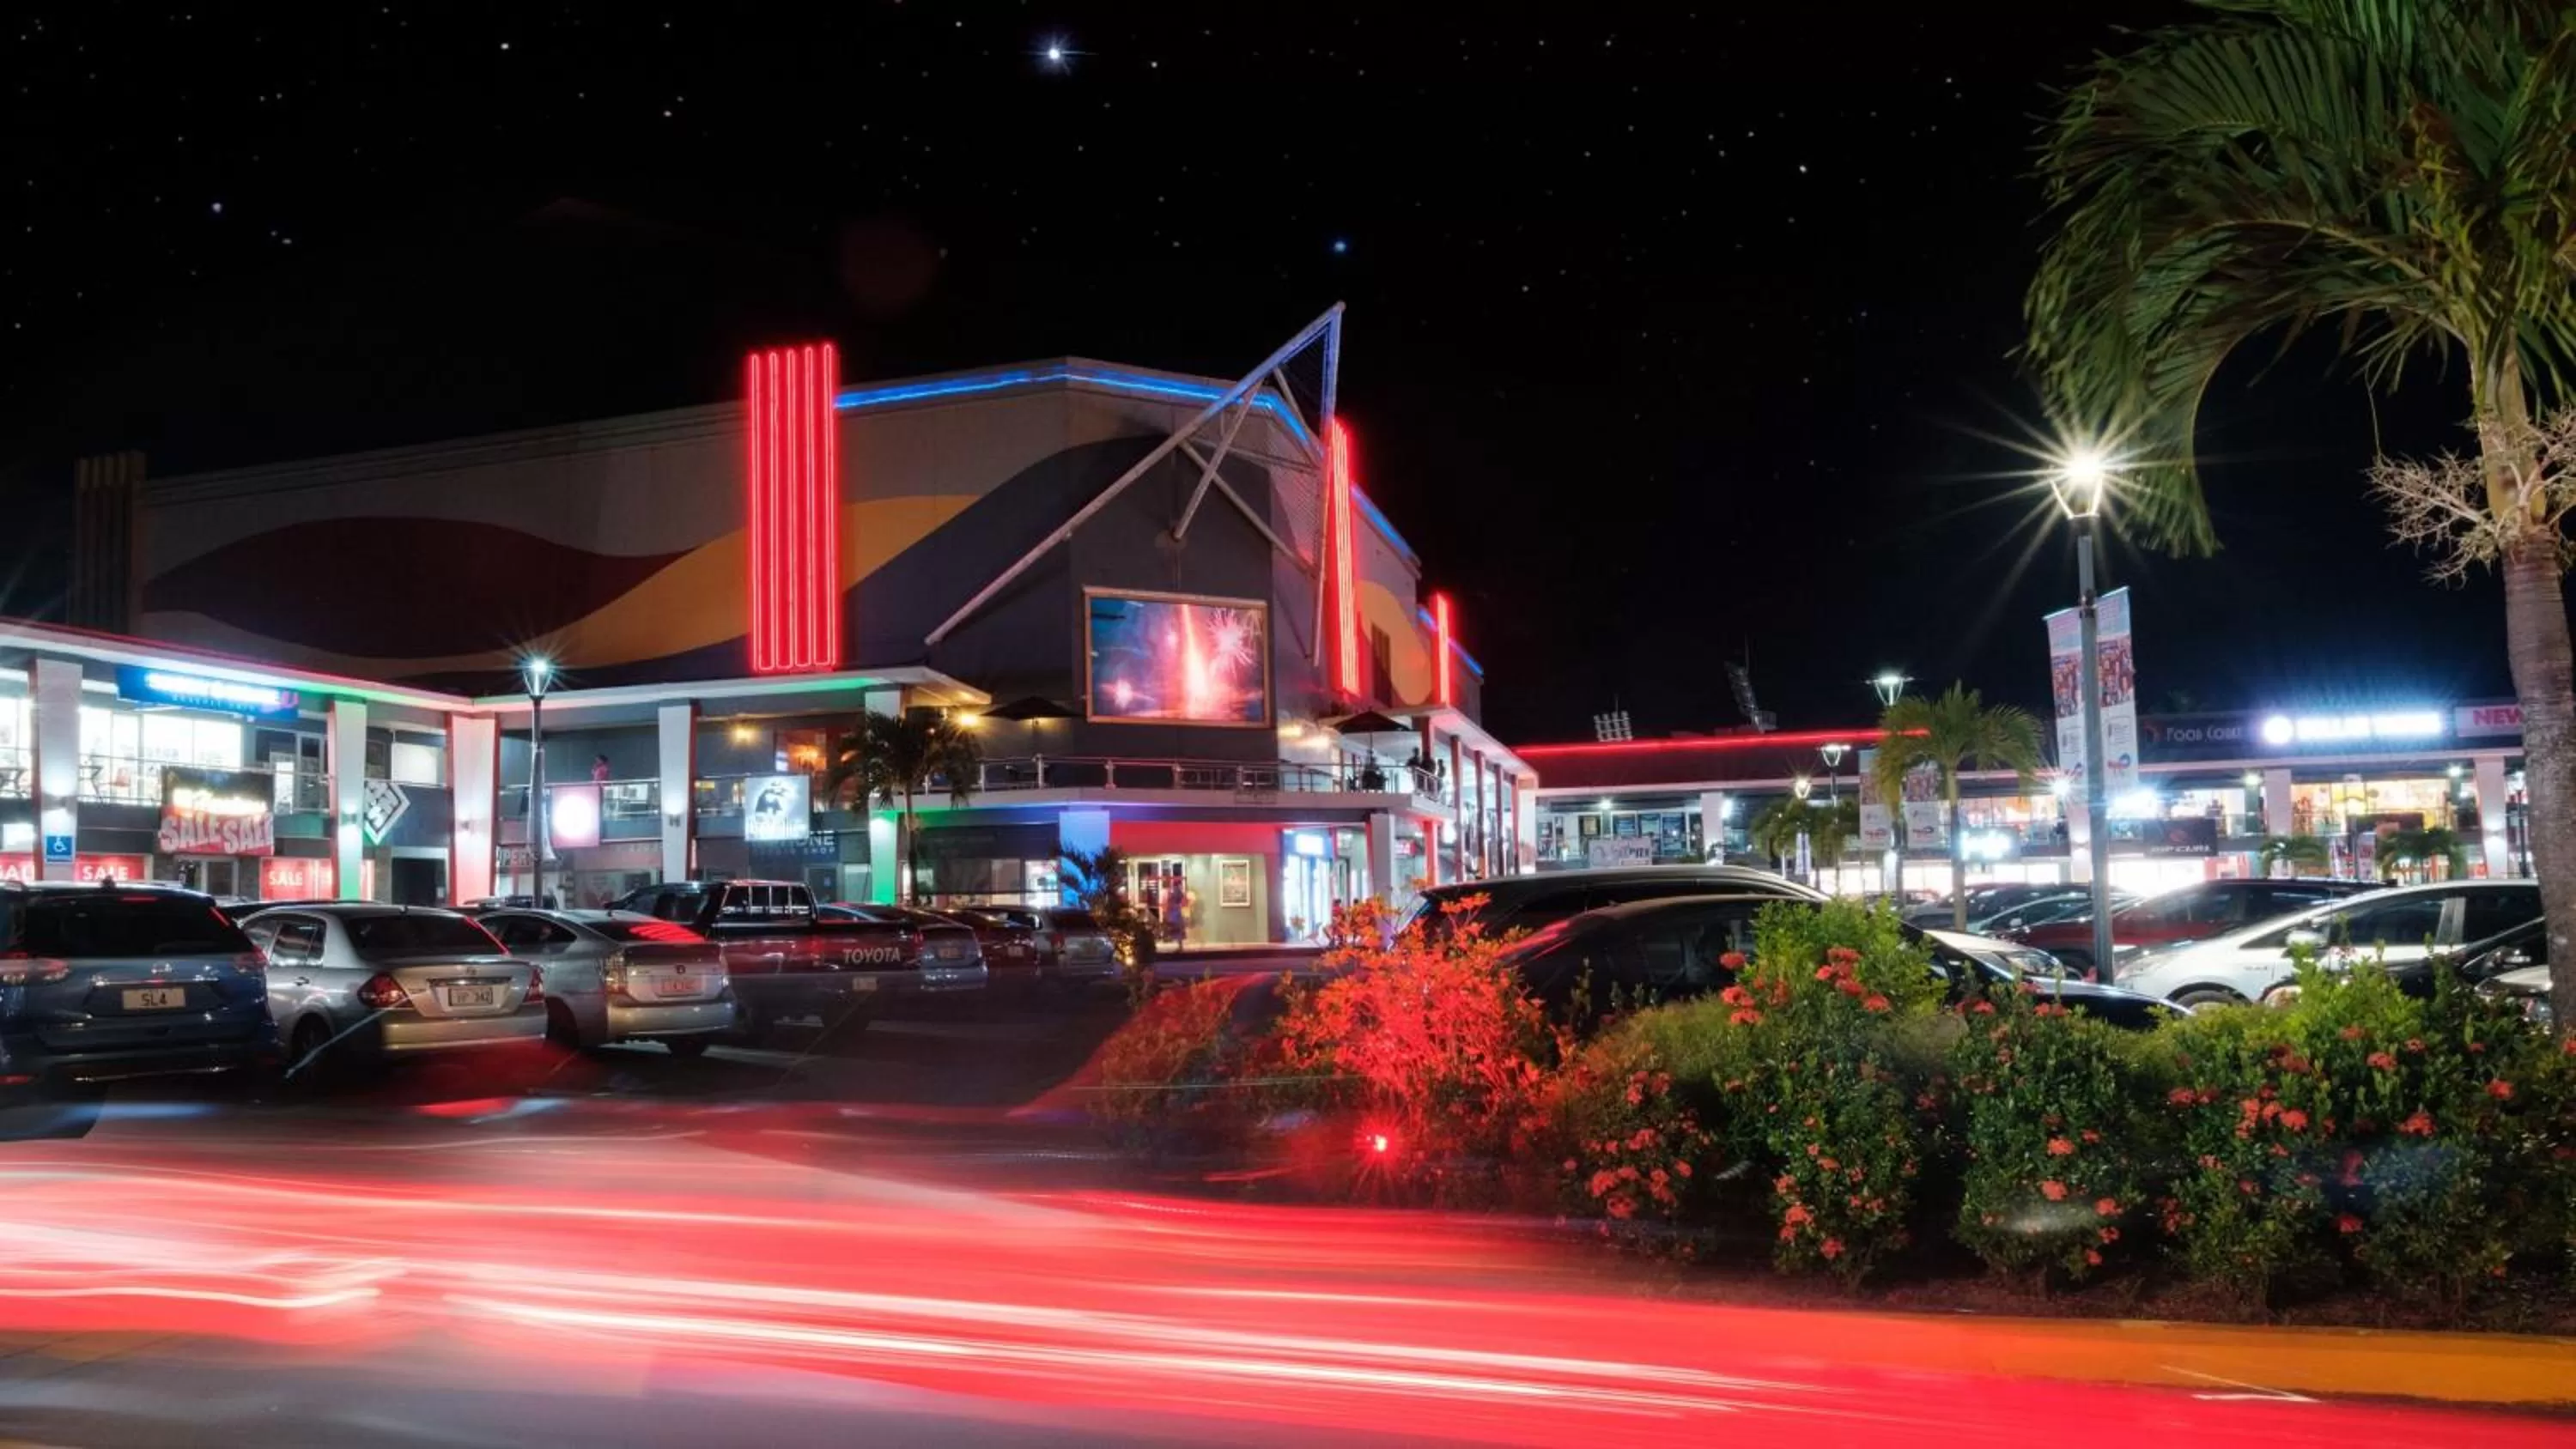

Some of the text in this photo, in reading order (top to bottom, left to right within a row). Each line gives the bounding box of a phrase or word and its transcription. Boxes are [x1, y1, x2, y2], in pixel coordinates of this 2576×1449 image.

[158, 814, 222, 852] SALE
[82, 865, 129, 881] SALE
[269, 870, 303, 887] SALE
[843, 947, 901, 964] TOYOTA
